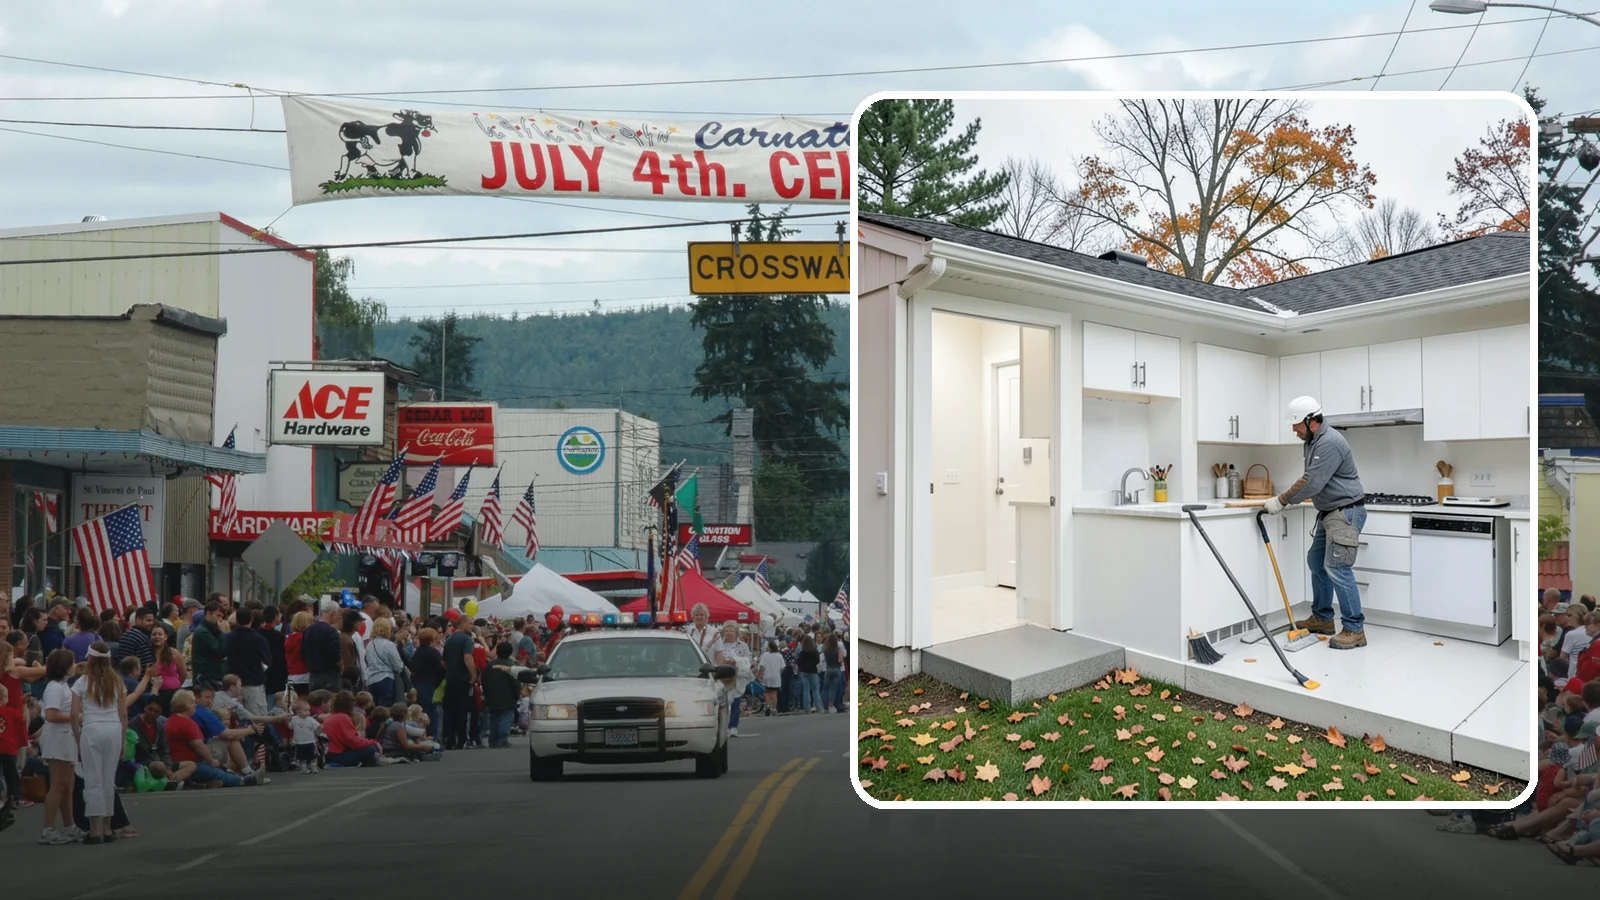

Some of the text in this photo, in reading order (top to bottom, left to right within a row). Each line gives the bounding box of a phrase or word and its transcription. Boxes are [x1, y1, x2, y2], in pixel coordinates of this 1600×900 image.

[481, 141, 604, 192] JULY
[632, 150, 746, 198] 4th.
[697, 254, 850, 279] CROSSWA
[283, 380, 373, 419] ACE
[406, 409, 452, 422] CEDAR
[283, 421, 370, 436] Hardware
[417, 428, 477, 447] Coca-Cola
[353, 467, 387, 481] Simpl
[96, 485, 124, 495] Vincent
[126, 486, 136, 495] de
[138, 486, 155, 495] Paul
[81, 503, 154, 522] THT
[213, 516, 331, 535] HARDARE
[688, 526, 742, 535] CRNATION
[699, 535, 731, 544] GLASS
